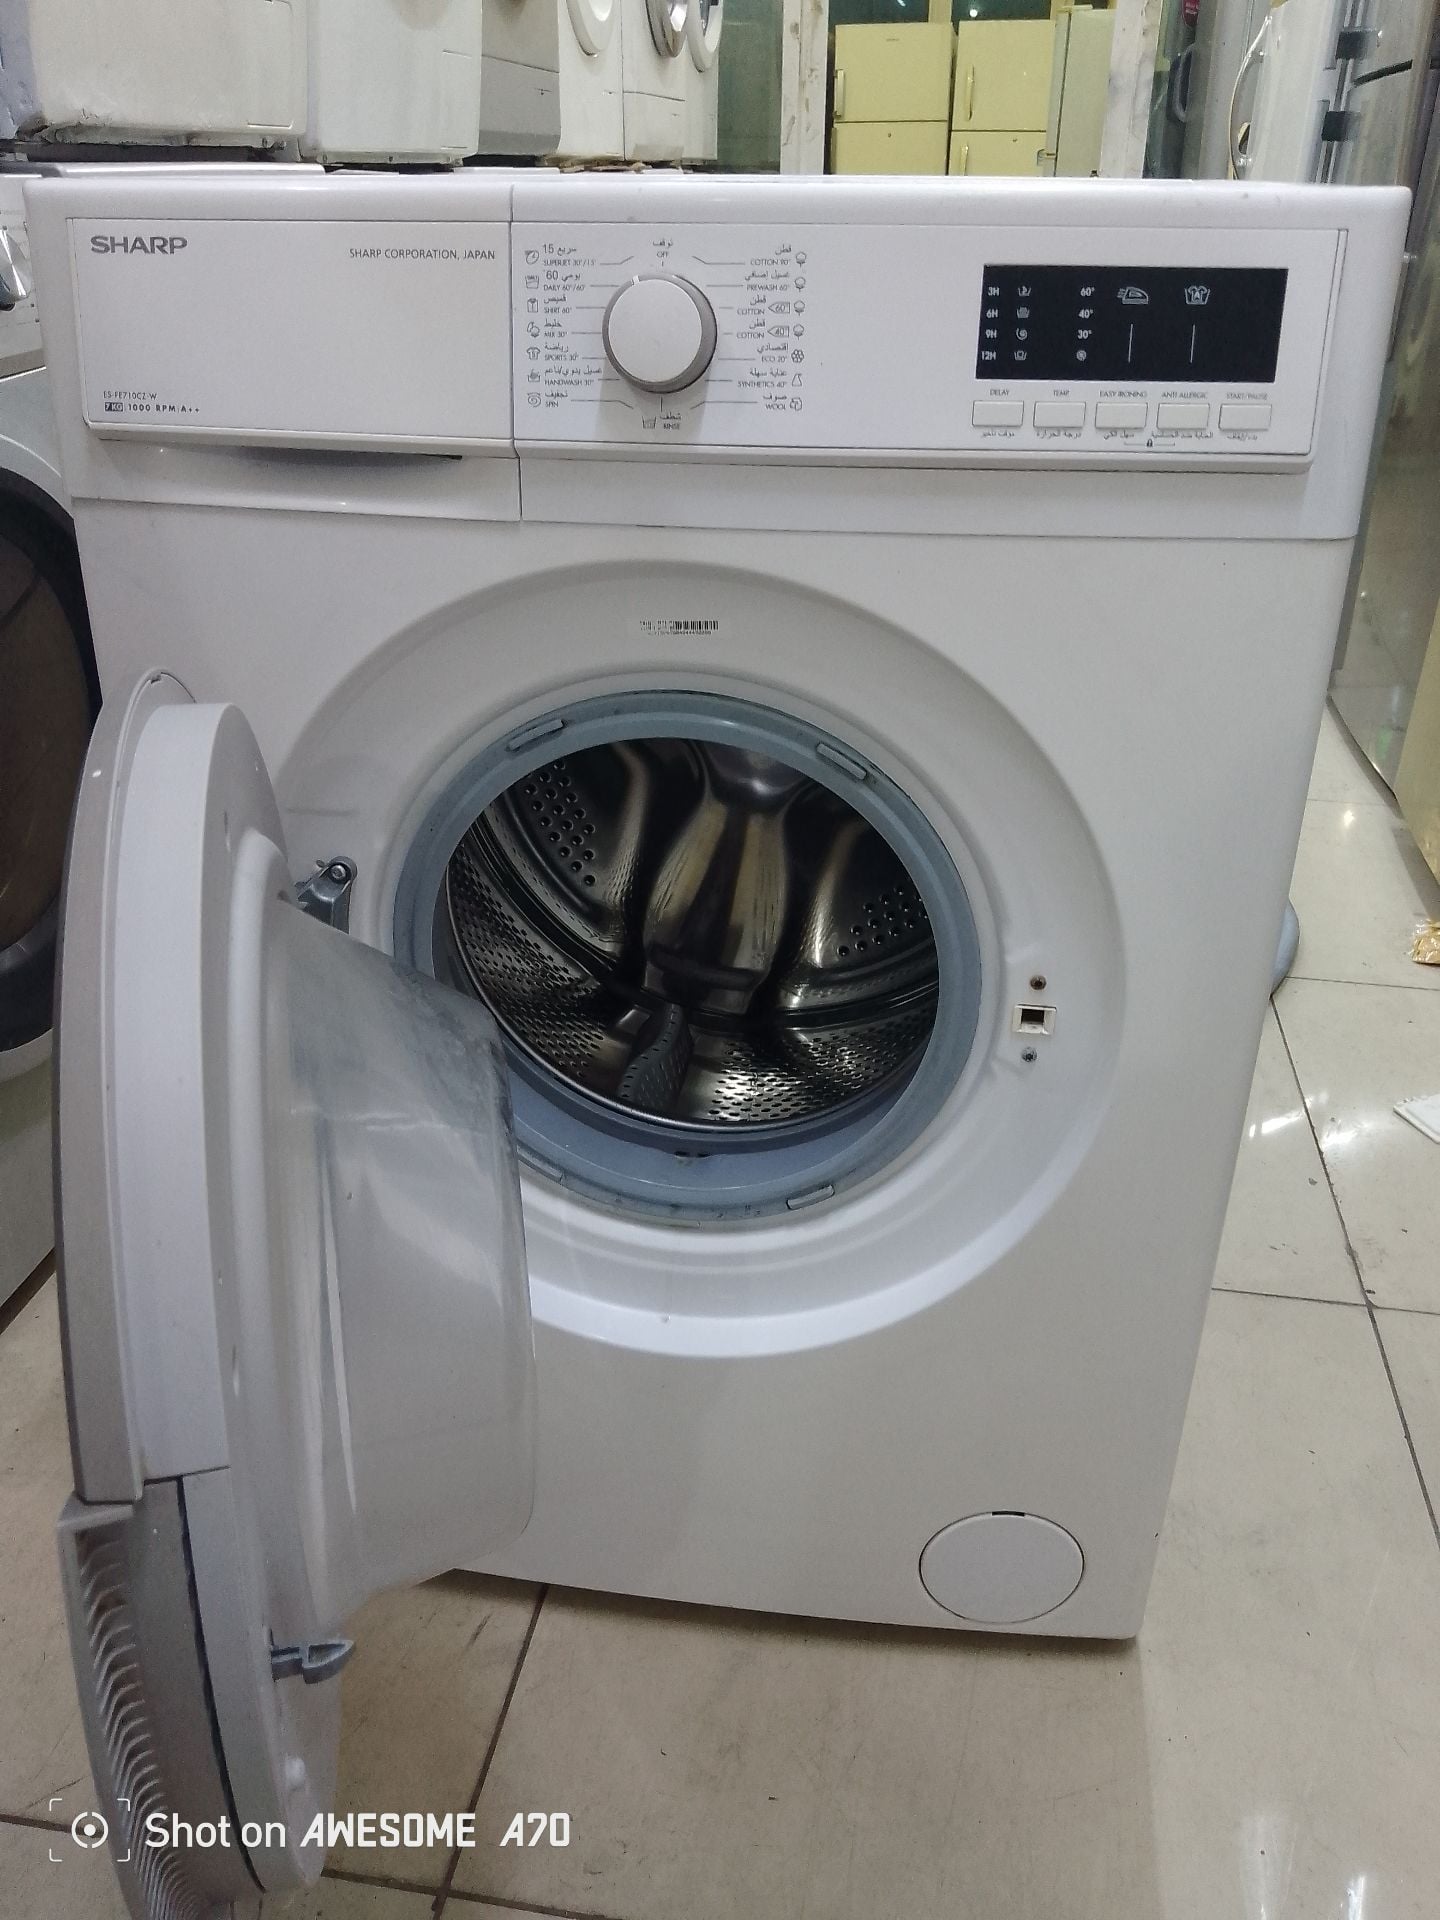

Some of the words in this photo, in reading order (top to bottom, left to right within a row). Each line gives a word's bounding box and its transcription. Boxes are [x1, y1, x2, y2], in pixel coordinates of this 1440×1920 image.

[90, 234, 188, 255] SHARP
[543, 243, 555, 254] 15
[349, 248, 382, 259] SHARP
[384, 248, 460, 261] CORPORATION,
[463, 249, 496, 260] JAPAN
[656, 250, 668, 258] OFF
[543, 284, 560, 292] DAILY
[746, 284, 778, 292] PREWASH
[987, 286, 1000, 297] 3H
[736, 308, 766, 316] COTTON
[985, 308, 999, 318] 6H
[736, 331, 765, 339] COTTON
[985, 329, 997, 339] 9H
[544, 353, 567, 361] SPORTS
[981, 350, 997, 361] 12H
[990, 388, 1009, 397] DELAY
[1161, 391, 1178, 399] ANTI
[128, 403, 151, 412] 1000
[155, 404, 176, 413] RPM
